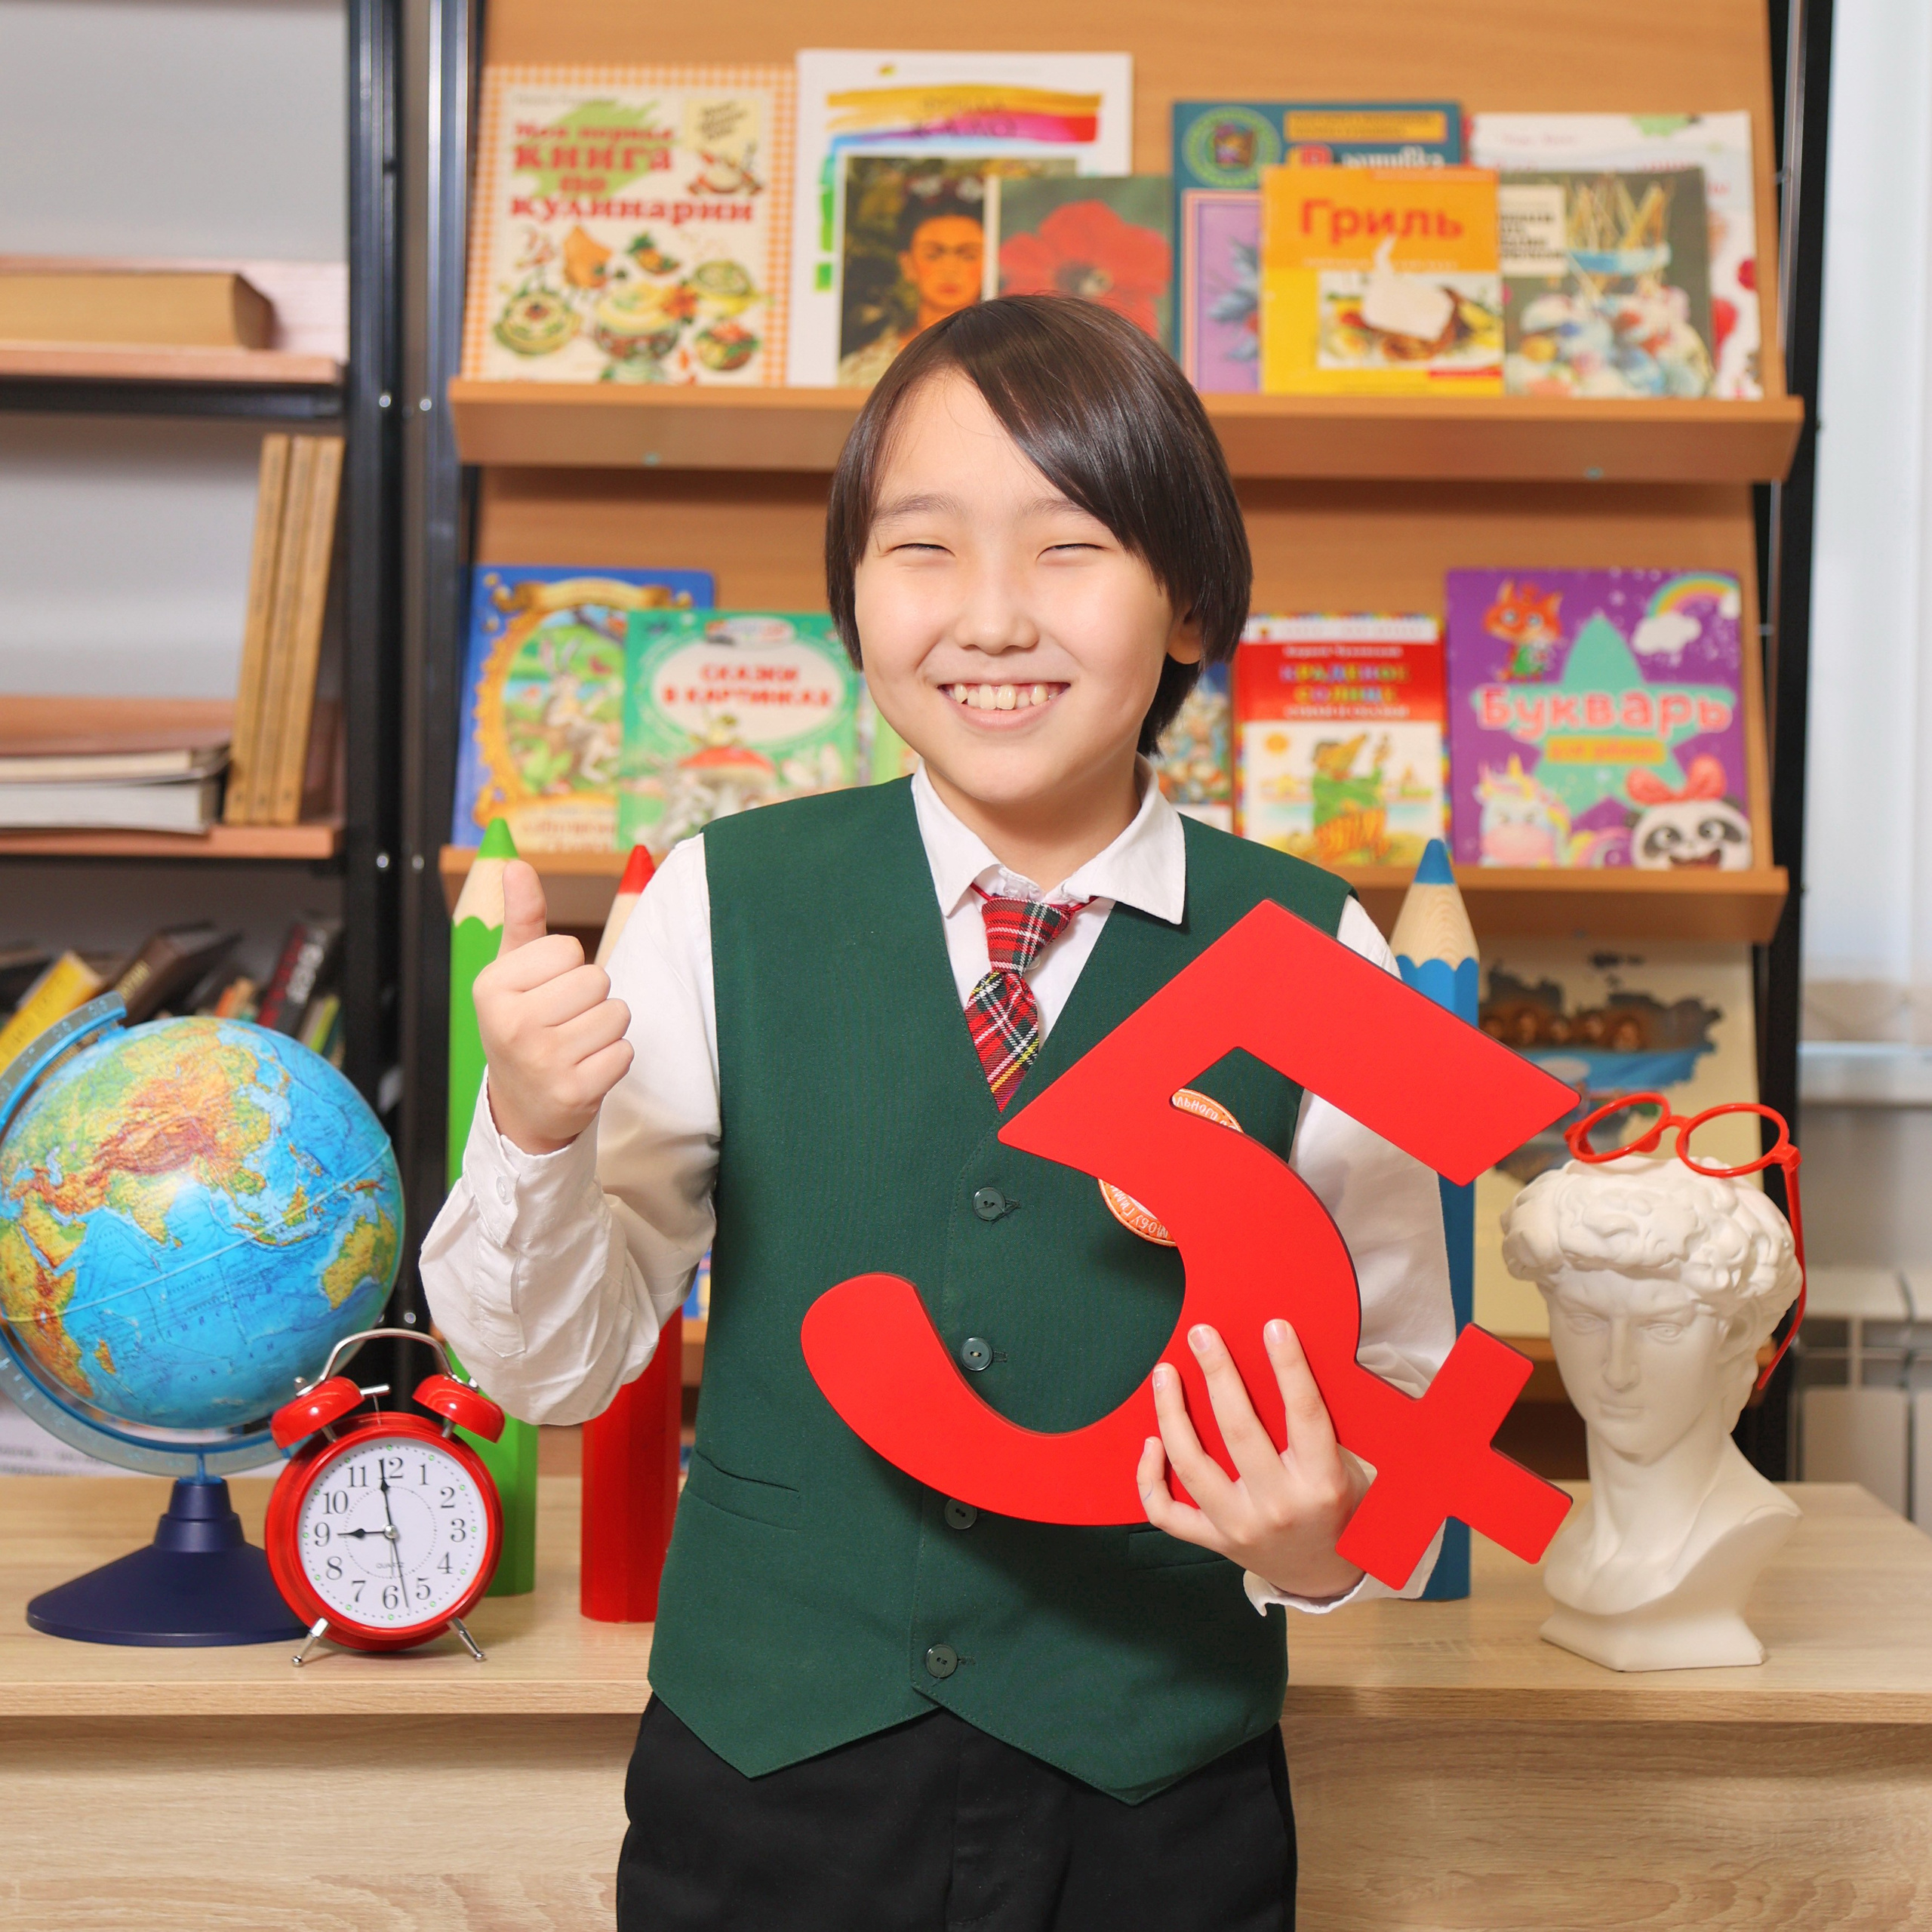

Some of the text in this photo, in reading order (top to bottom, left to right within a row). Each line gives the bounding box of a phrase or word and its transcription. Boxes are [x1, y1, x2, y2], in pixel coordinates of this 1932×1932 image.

[1302, 198, 1464, 246] Гриль
[1480, 686, 1733, 742] Букварь
[347, 1466, 369, 1487] 11
[378, 1457, 404, 1479] 12
[420, 1463, 429, 1486] 1
[322, 1491, 348, 1515] 10
[440, 1487, 455, 1508] 2
[314, 1522, 330, 1546] 9
[451, 1518, 466, 1543] 3
[326, 1556, 343, 1580] 8
[437, 1552, 453, 1574] 4
[352, 1580, 366, 1602] 7
[383, 1586, 398, 1610] 6
[416, 1577, 431, 1600] 5
